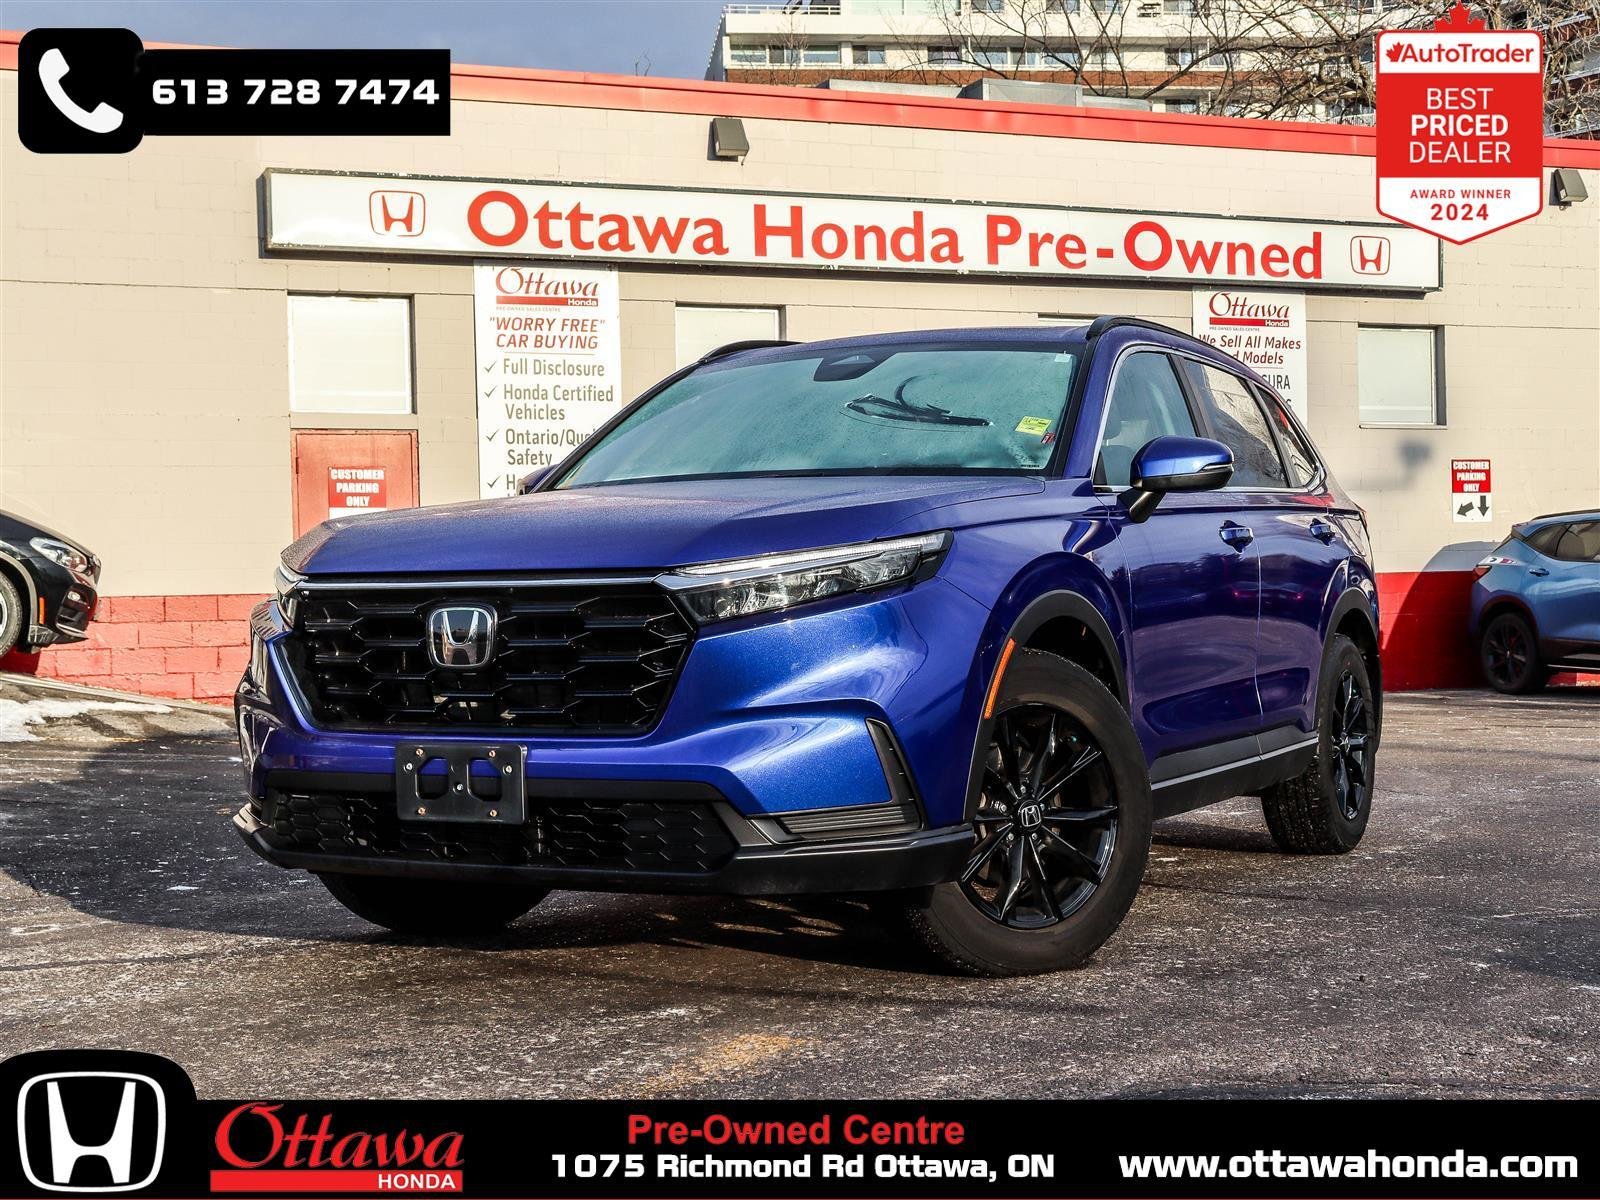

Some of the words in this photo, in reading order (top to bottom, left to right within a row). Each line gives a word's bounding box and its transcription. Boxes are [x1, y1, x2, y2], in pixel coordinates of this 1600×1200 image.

[467, 190, 729, 256] Ottawa
[753, 203, 964, 265] Honda
[985, 214, 1322, 280] Pre-Owned
[495, 266, 599, 296] Ottawa
[567, 298, 598, 306] Honda
[1208, 292, 1290, 318] Ottawa
[1264, 319, 1289, 327] Honda
[496, 334, 529, 348] CAR
[534, 335, 598, 349] BUYING
[1220, 335, 1241, 348] Sell
[1245, 336, 1260, 349] All
[1264, 336, 1301, 350] Makes
[1242, 351, 1284, 365] Models
[503, 358, 528, 375] Full
[533, 359, 605, 376] Disclosure
[504, 384, 548, 400] Honda
[553, 385, 614, 402] Certified
[505, 403, 566, 420] Vehicles
[507, 448, 553, 465] Safety
[1453, 461, 1490, 470] CUSTOMER
[330, 469, 385, 480] CUSTOMER
[1456, 472, 1487, 481] PARKING
[336, 482, 380, 493] PARKING
[1463, 483, 1480, 492] ONLY
[346, 495, 370, 507] ONLY
